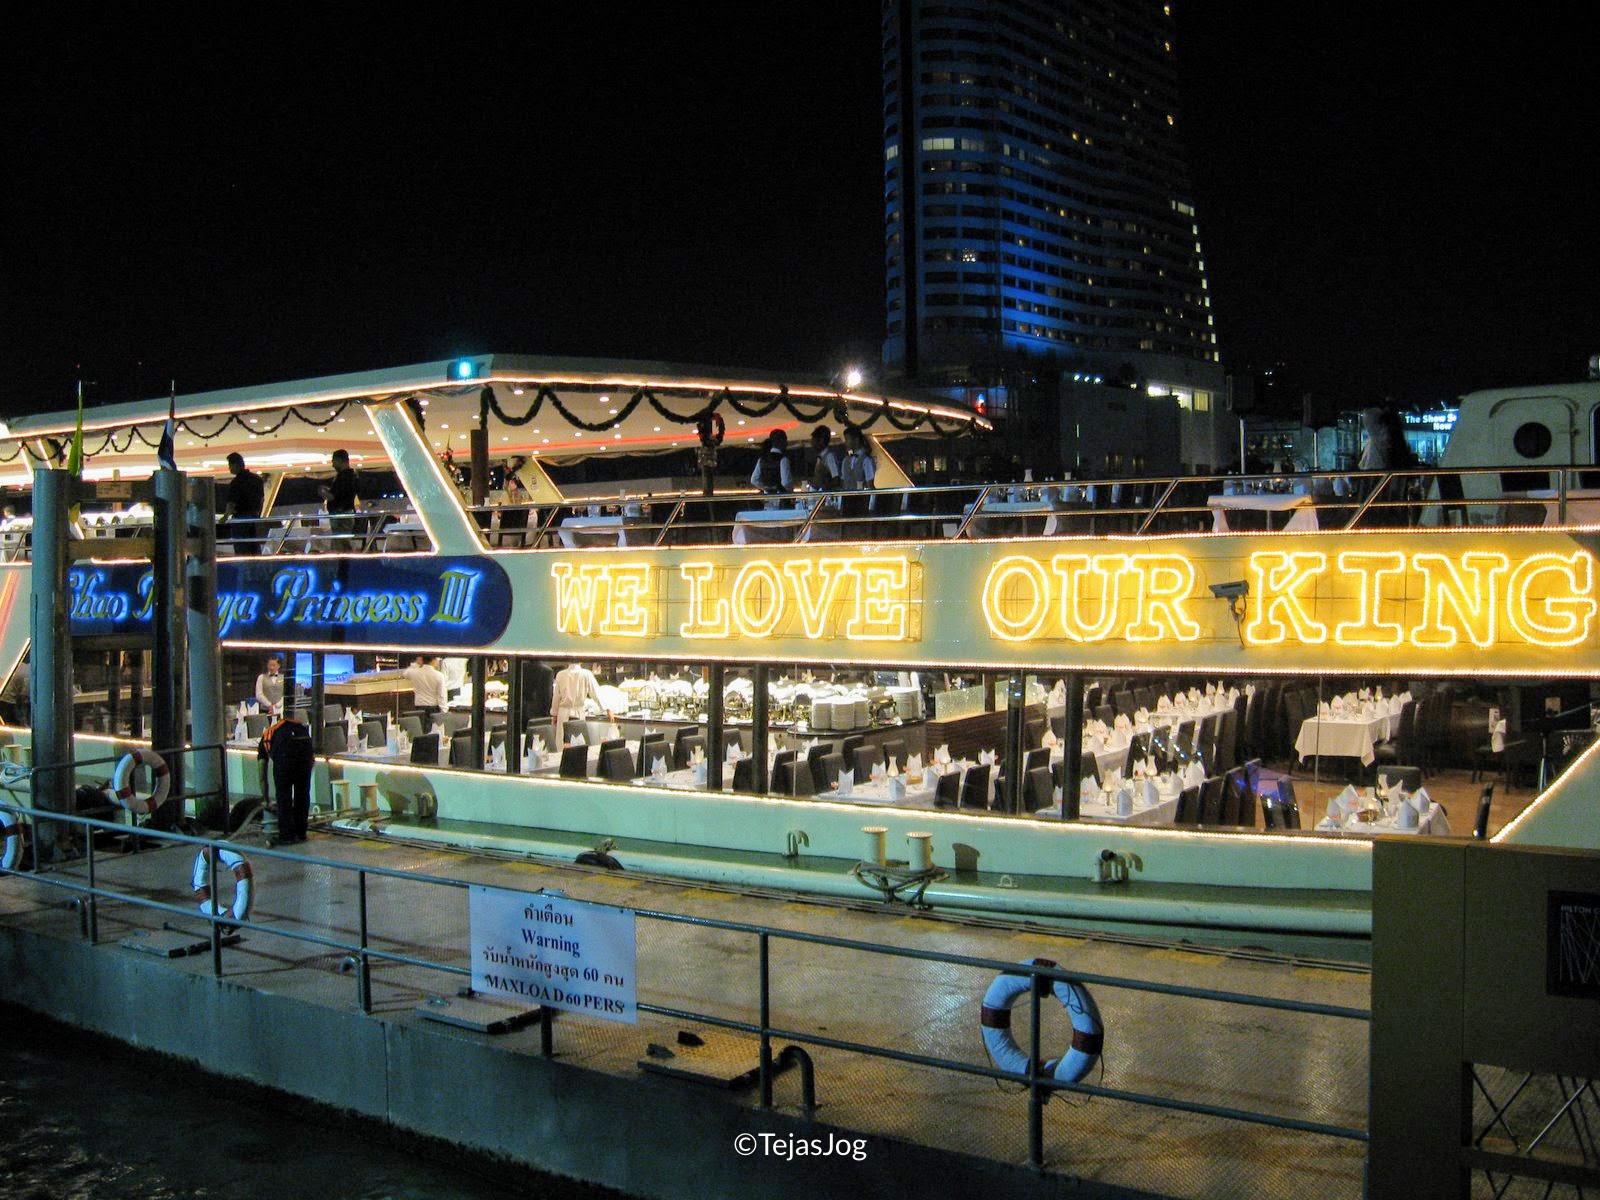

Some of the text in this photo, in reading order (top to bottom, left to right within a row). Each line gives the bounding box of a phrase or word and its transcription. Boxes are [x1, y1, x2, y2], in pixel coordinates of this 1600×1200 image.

[1404, 415, 1421, 424] The
[1422, 414, 1446, 424] Show
[264, 568, 423, 623] Princess
[551, 551, 1598, 647] WE LOVE OUR KING
[524, 903, 574, 927] คำเตือน
[521, 928, 581, 958] Warning
[583, 967, 599, 982] 60
[565, 993, 581, 1006] 60
[584, 994, 625, 1014] PERS
